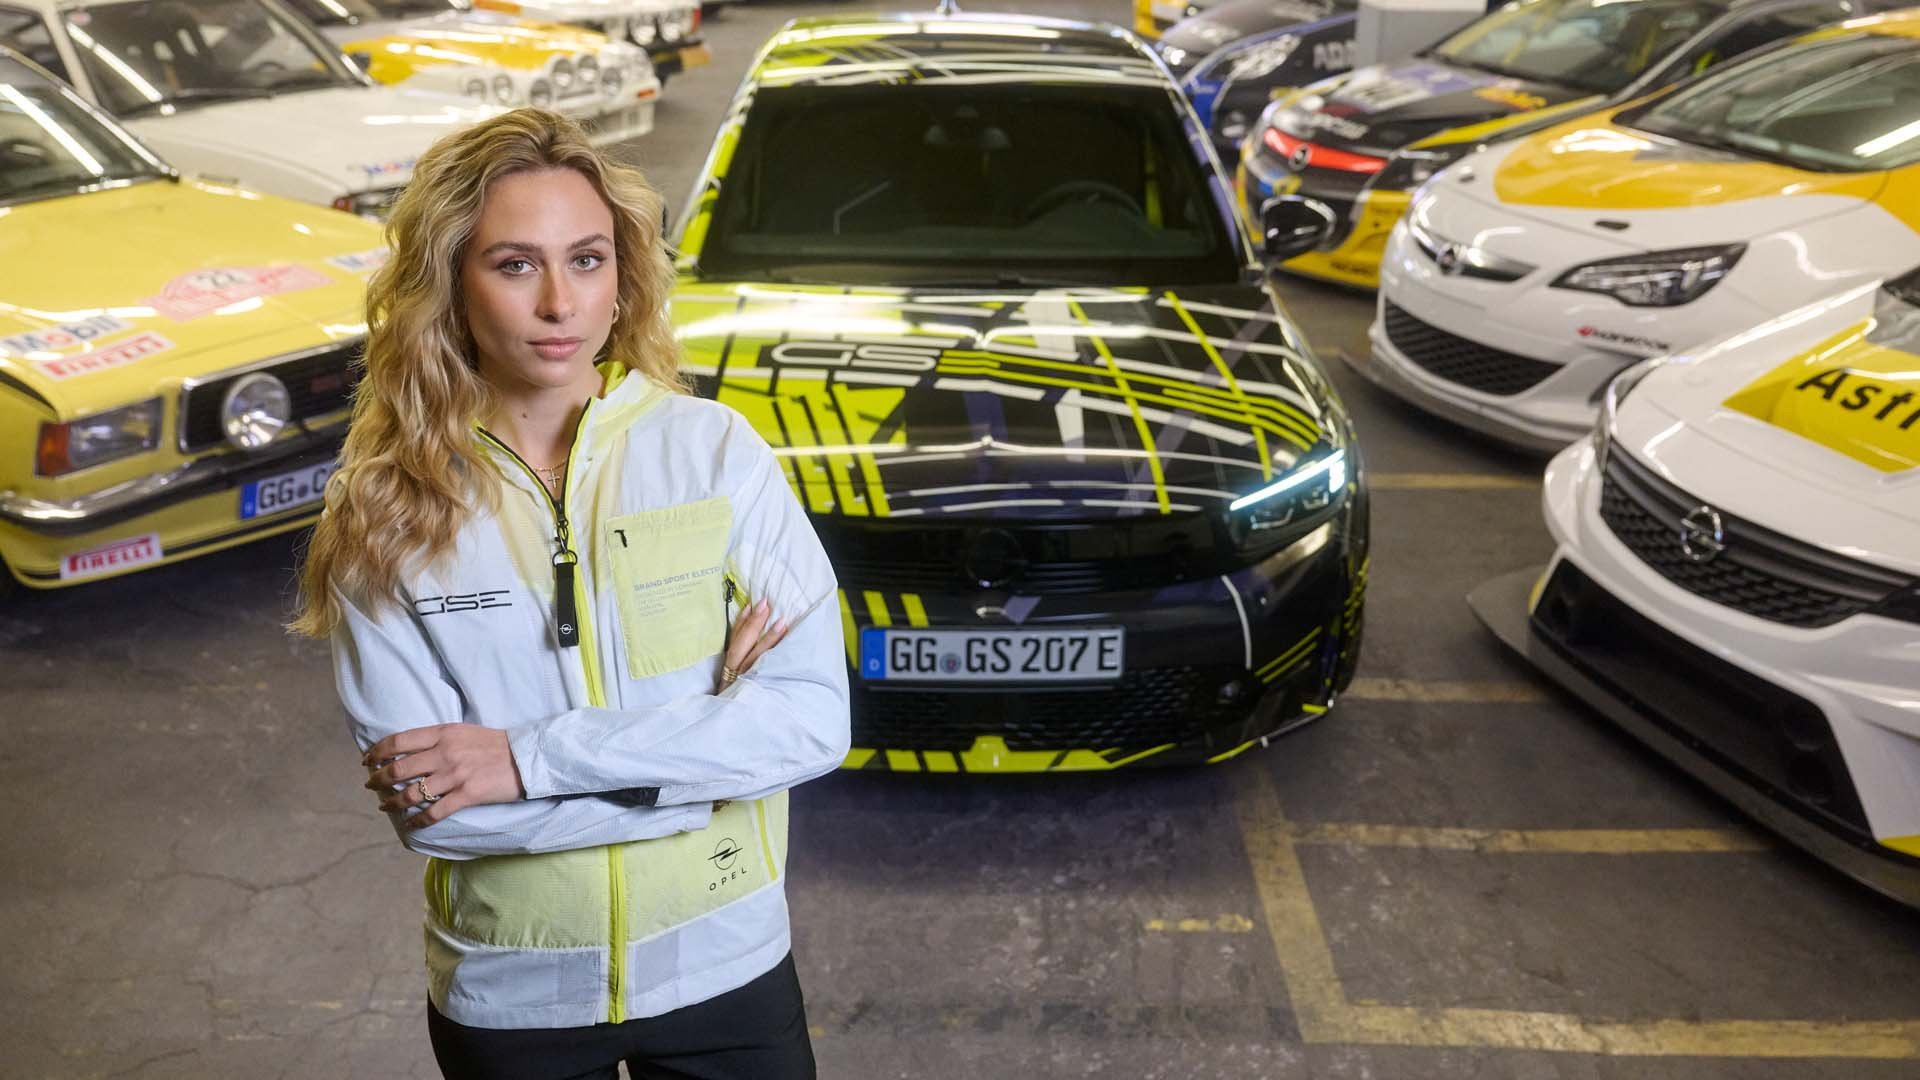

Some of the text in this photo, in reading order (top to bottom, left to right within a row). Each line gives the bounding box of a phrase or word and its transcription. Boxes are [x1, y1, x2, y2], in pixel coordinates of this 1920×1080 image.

[44, 335, 164, 376] PIRELLI
[260, 477, 295, 508] GG
[68, 536, 152, 573] PIRELLI
[664, 573, 690, 585] SPORT
[414, 590, 513, 616] GSE
[890, 636, 1119, 673] GG GS 207 E
[709, 866, 748, 891] OPEL
